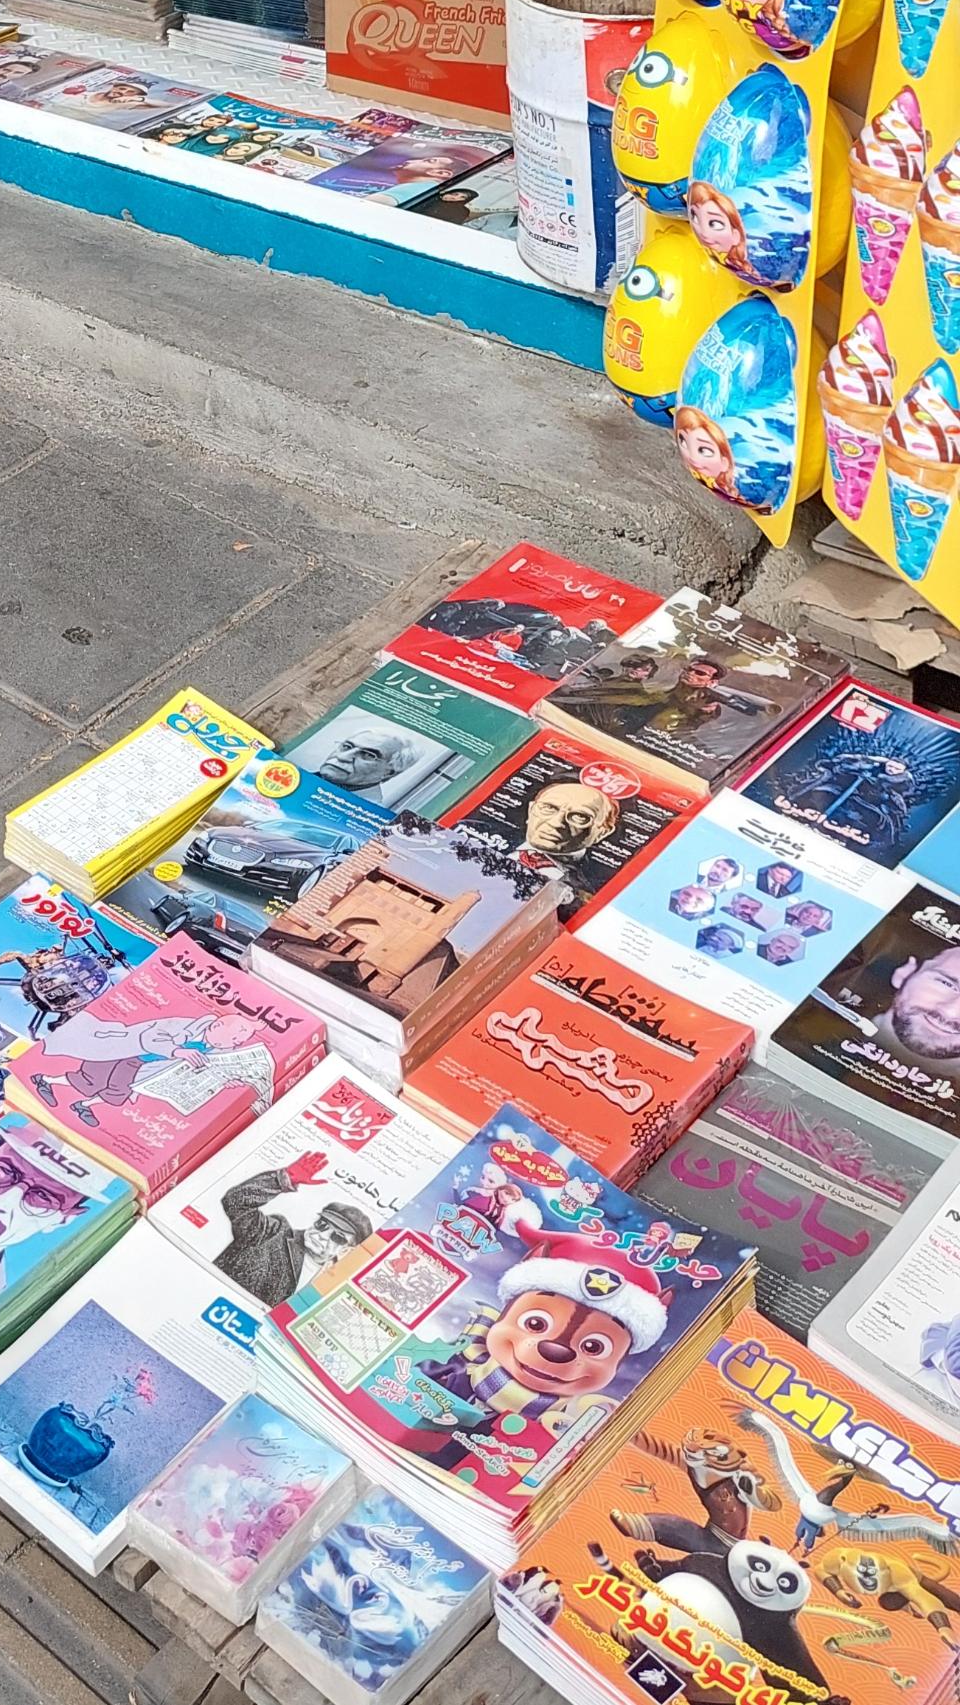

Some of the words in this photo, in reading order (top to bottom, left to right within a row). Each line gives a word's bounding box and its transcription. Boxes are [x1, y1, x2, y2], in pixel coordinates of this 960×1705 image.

[352, 3, 485, 56] QUEEN
[424, 1, 475, 22] French
[479, 6, 506, 25] Fri
[21, 894, 97, 938] نوآور
[841, 1037, 930, 1088] جاودانگی
[929, 1079, 955, 1098] راز
[493, 1147, 522, 1164] خونه
[536, 1164, 567, 1183] خونه
[435, 1201, 504, 1256] PAW
[435, 1227, 478, 1261] PATROL
[628, 1241, 723, 1289] جدول
